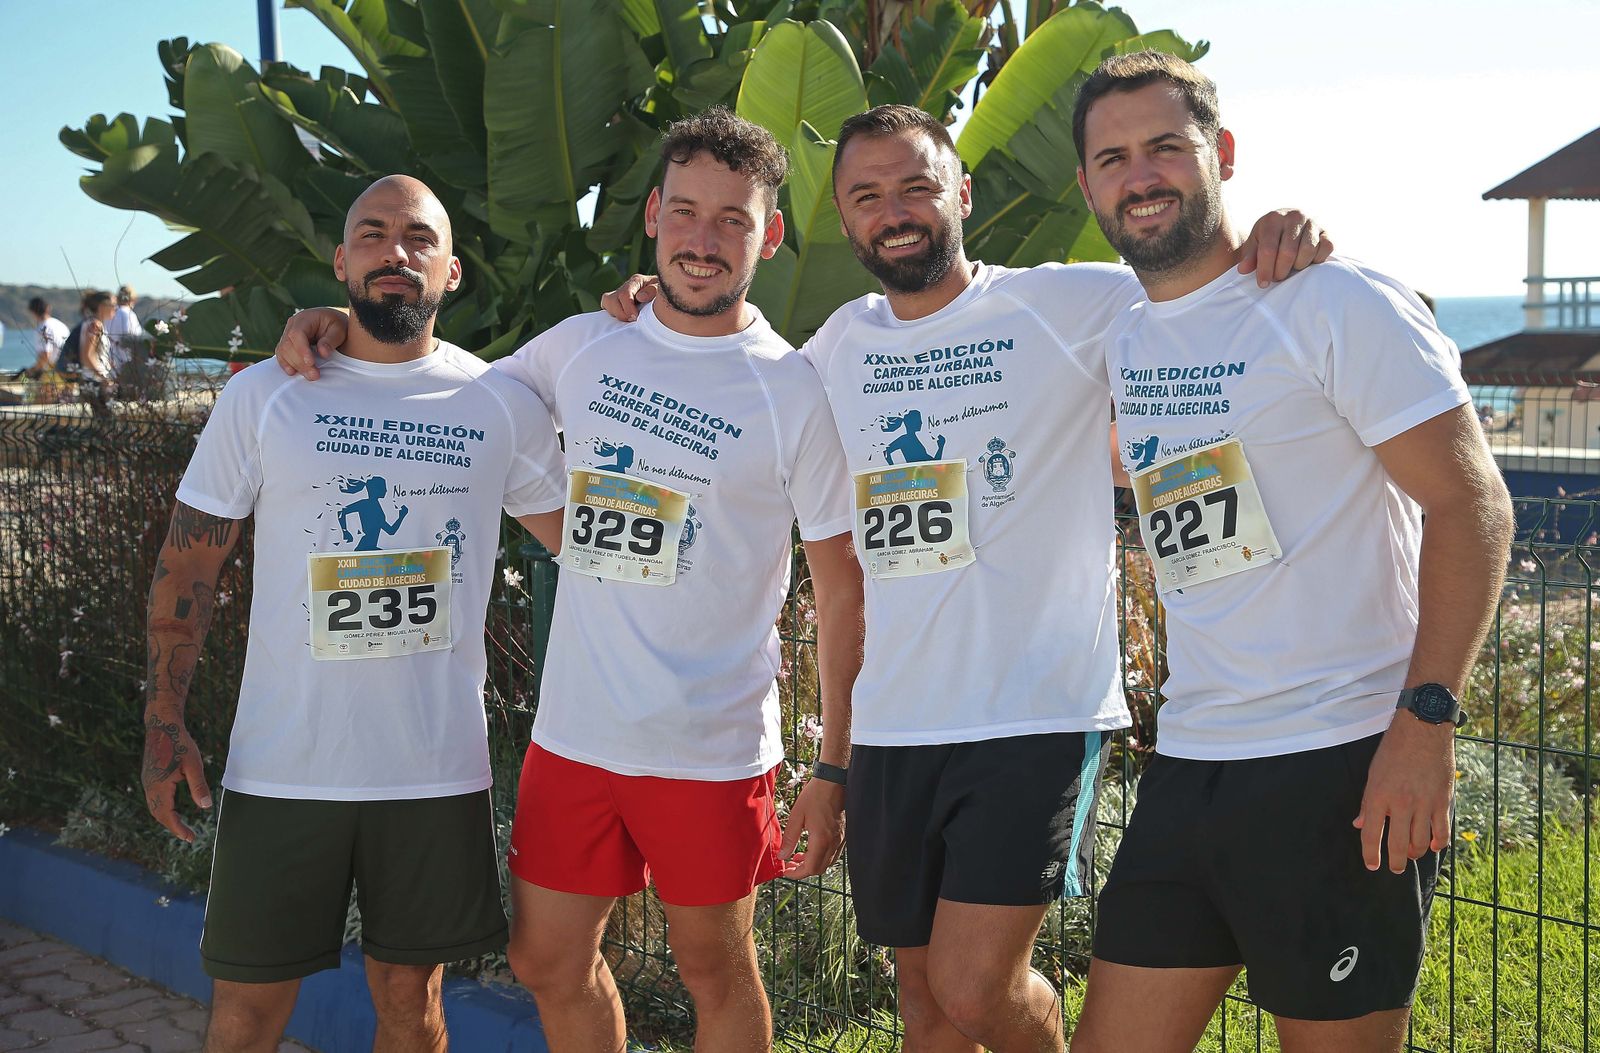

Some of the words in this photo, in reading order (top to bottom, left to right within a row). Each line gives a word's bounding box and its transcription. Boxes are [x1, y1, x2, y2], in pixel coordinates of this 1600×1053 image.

[864, 354, 908, 364] XXIII
[914, 338, 1014, 364] EDICIÓN
[874, 365, 930, 379] CARRERA
[934, 356, 994, 372] URBANA
[1120, 367, 1152, 381] XXIII
[1158, 362, 1245, 380] EDICIÓN
[863, 380, 903, 394] CIUDAD
[908, 379, 924, 391] DE
[928, 371, 1002, 390] ALGECIRAS
[1126, 384, 1169, 398] CARRERA
[1172, 382, 1222, 397] URBANA
[598, 374, 645, 398] XXIII
[650, 392, 742, 438] EDICIÓN
[602, 390, 660, 420] CARRERA
[663, 412, 716, 444] URBANA
[928, 415, 940, 429] No
[943, 414, 958, 424] nos
[962, 401, 1009, 420] detenemos
[1120, 402, 1148, 415] CIUDAD
[1150, 403, 1163, 416] DE
[1165, 400, 1230, 416] ALGECIRAS
[314, 414, 373, 428] XXIII
[383, 419, 484, 441] EDICIÓN
[328, 428, 400, 444] CARRERA
[406, 434, 466, 452] URBANA
[588, 401, 630, 423] CIUDAD
[632, 417, 650, 430] DE
[650, 425, 719, 460] ALGECIRAS
[316, 441, 369, 456] CIUDAD
[374, 446, 392, 458] DE
[397, 448, 472, 468] ALGECIRAS
[1161, 442, 1171, 458] No
[1173, 445, 1187, 454] nos
[638, 458, 649, 471] No
[651, 466, 666, 476] nos
[668, 466, 712, 486] detenemos
[393, 484, 406, 498] No
[410, 488, 426, 496] nos
[430, 482, 470, 495] detenemos
[870, 494, 891, 505] CIUDAD
[892, 493, 898, 502] DE
[900, 489, 938, 501] ALGECIRAS
[1153, 493, 1174, 508] CIUDAD
[1174, 489, 1183, 500] DE
[1184, 476, 1222, 497] ALGECIRAS
[585, 495, 605, 506] CIUDAD
[606, 498, 615, 507] DE
[615, 500, 656, 516] ALGECIRAS
[572, 506, 664, 556] 329
[864, 501, 953, 550] 226
[1150, 486, 1238, 559] 227
[1202, 542, 1236, 555] FRANCISCO
[338, 558, 357, 568] XXIII
[338, 579, 371, 588] CIUDAD
[373, 578, 384, 586] DE
[385, 574, 426, 586] ALGECIRAS
[327, 584, 438, 632] 235
